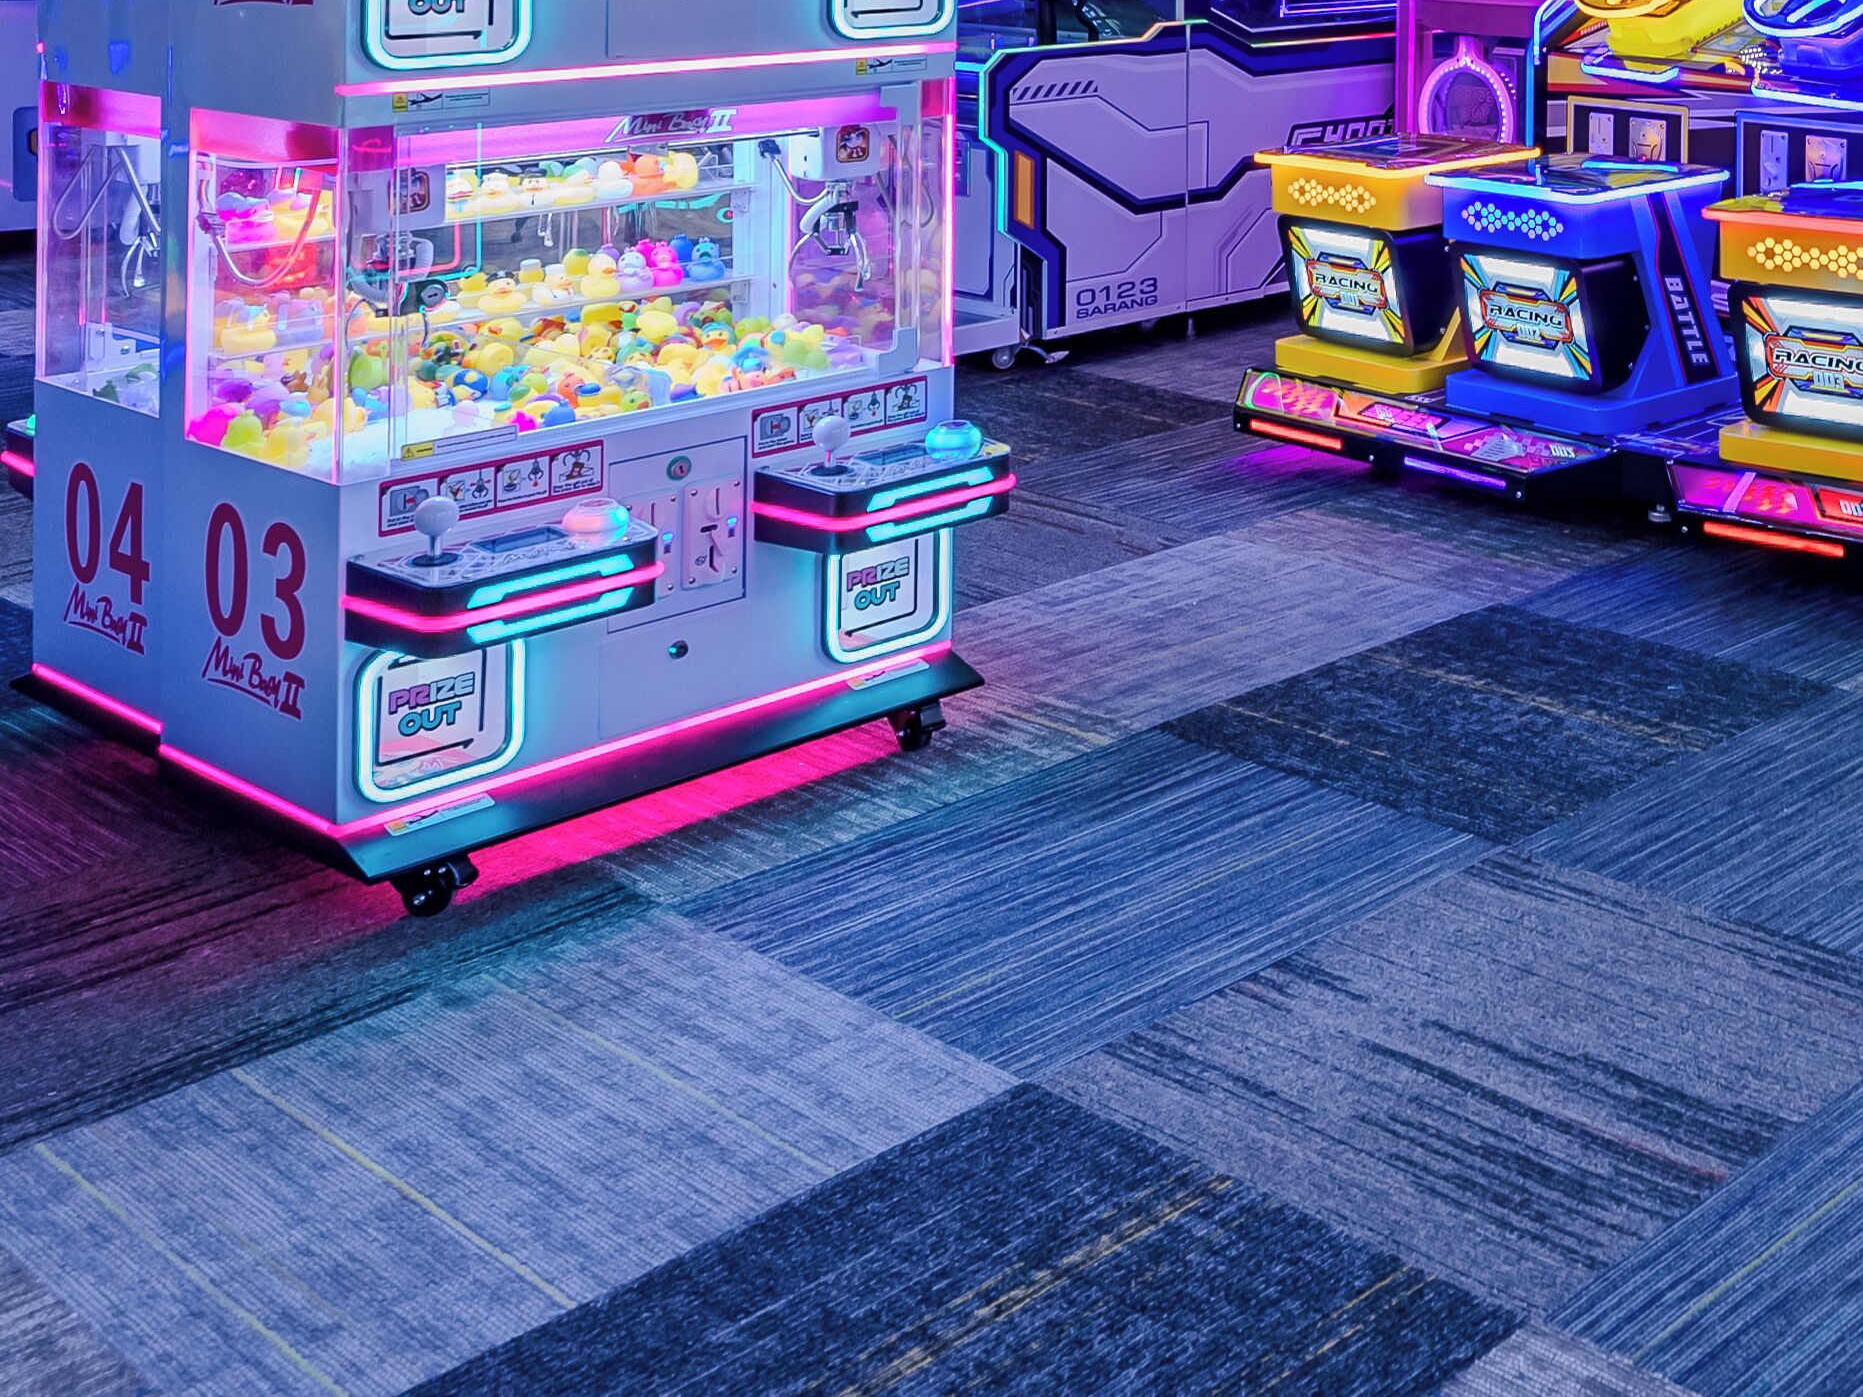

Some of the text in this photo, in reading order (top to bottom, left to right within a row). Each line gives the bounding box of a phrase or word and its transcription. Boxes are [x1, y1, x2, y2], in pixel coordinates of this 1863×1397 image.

[1076, 277, 1159, 307] 0123
[1315, 273, 1379, 294] RACING
[1076, 295, 1158, 320] SARANG
[1488, 303, 1566, 327] RACING
[1663, 274, 1709, 366] BATTLE
[66, 462, 150, 605] 04
[205, 502, 306, 660] 03
[847, 556, 910, 592] PRIZE
[853, 581, 900, 612] OUT
[388, 670, 476, 716] PRIZE
[398, 701, 463, 737] OUT
